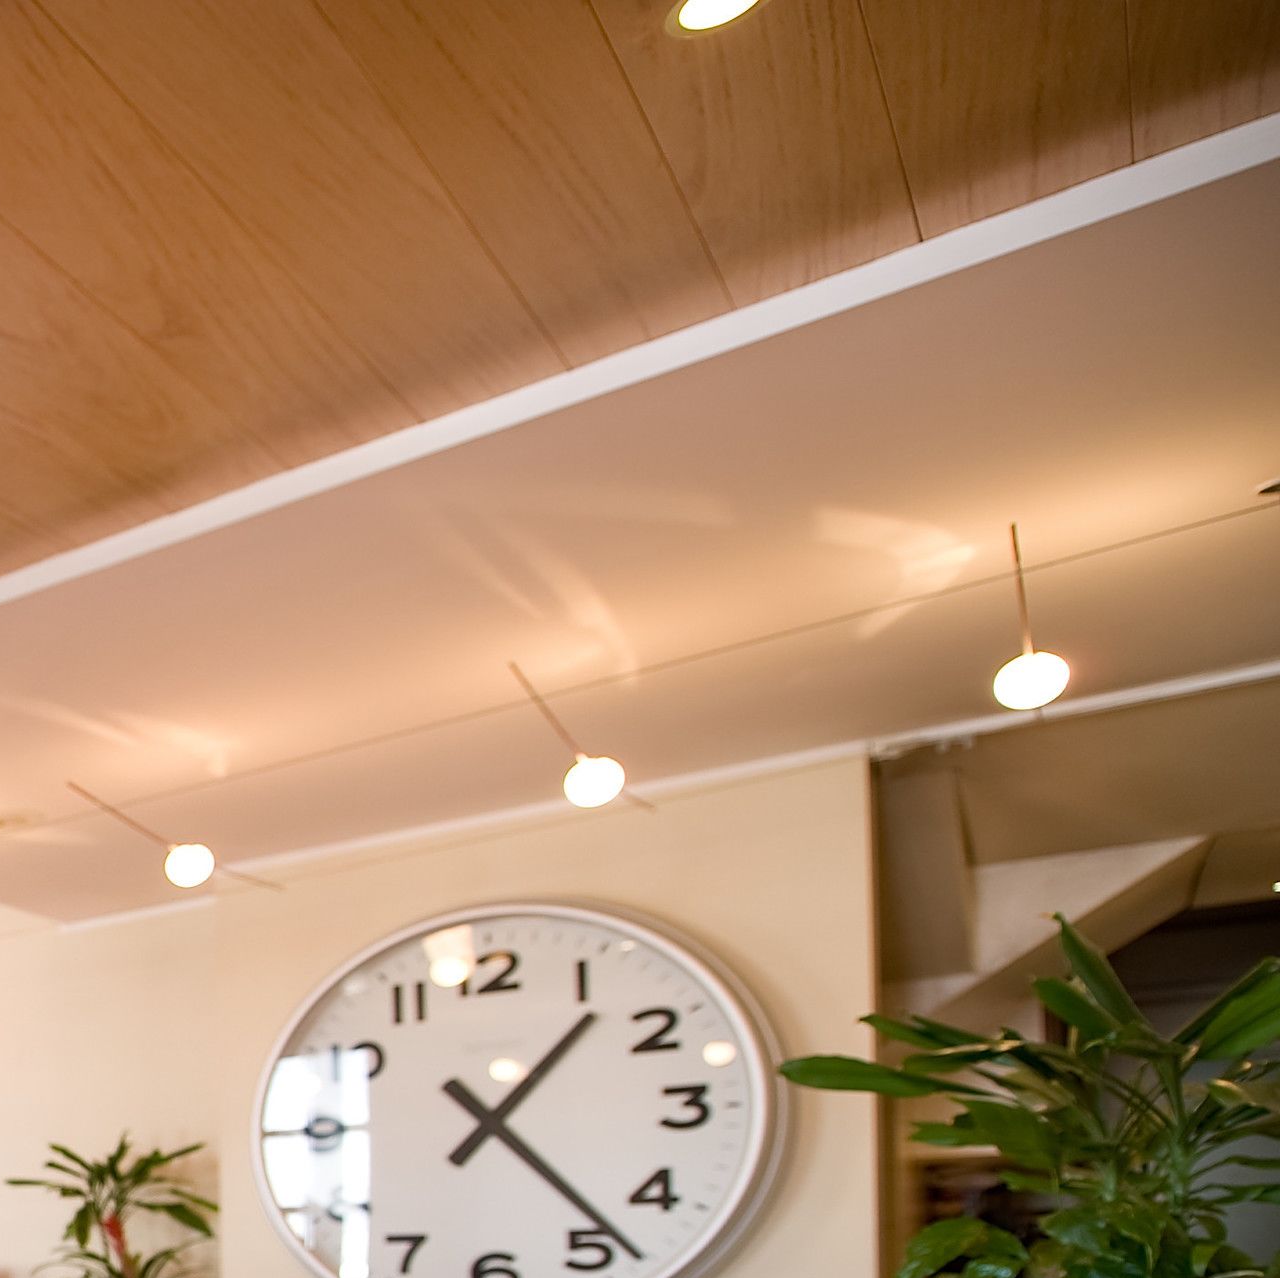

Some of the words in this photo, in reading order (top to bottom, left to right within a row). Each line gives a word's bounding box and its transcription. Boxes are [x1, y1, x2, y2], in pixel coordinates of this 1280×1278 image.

[393, 981, 426, 1025] 11
[577, 960, 587, 1002] 1
[631, 1008, 681, 1054] 2
[660, 1085, 711, 1129] 3
[628, 1167, 682, 1212] 4
[386, 1234, 429, 1275] 7
[565, 1229, 614, 1272] 5
